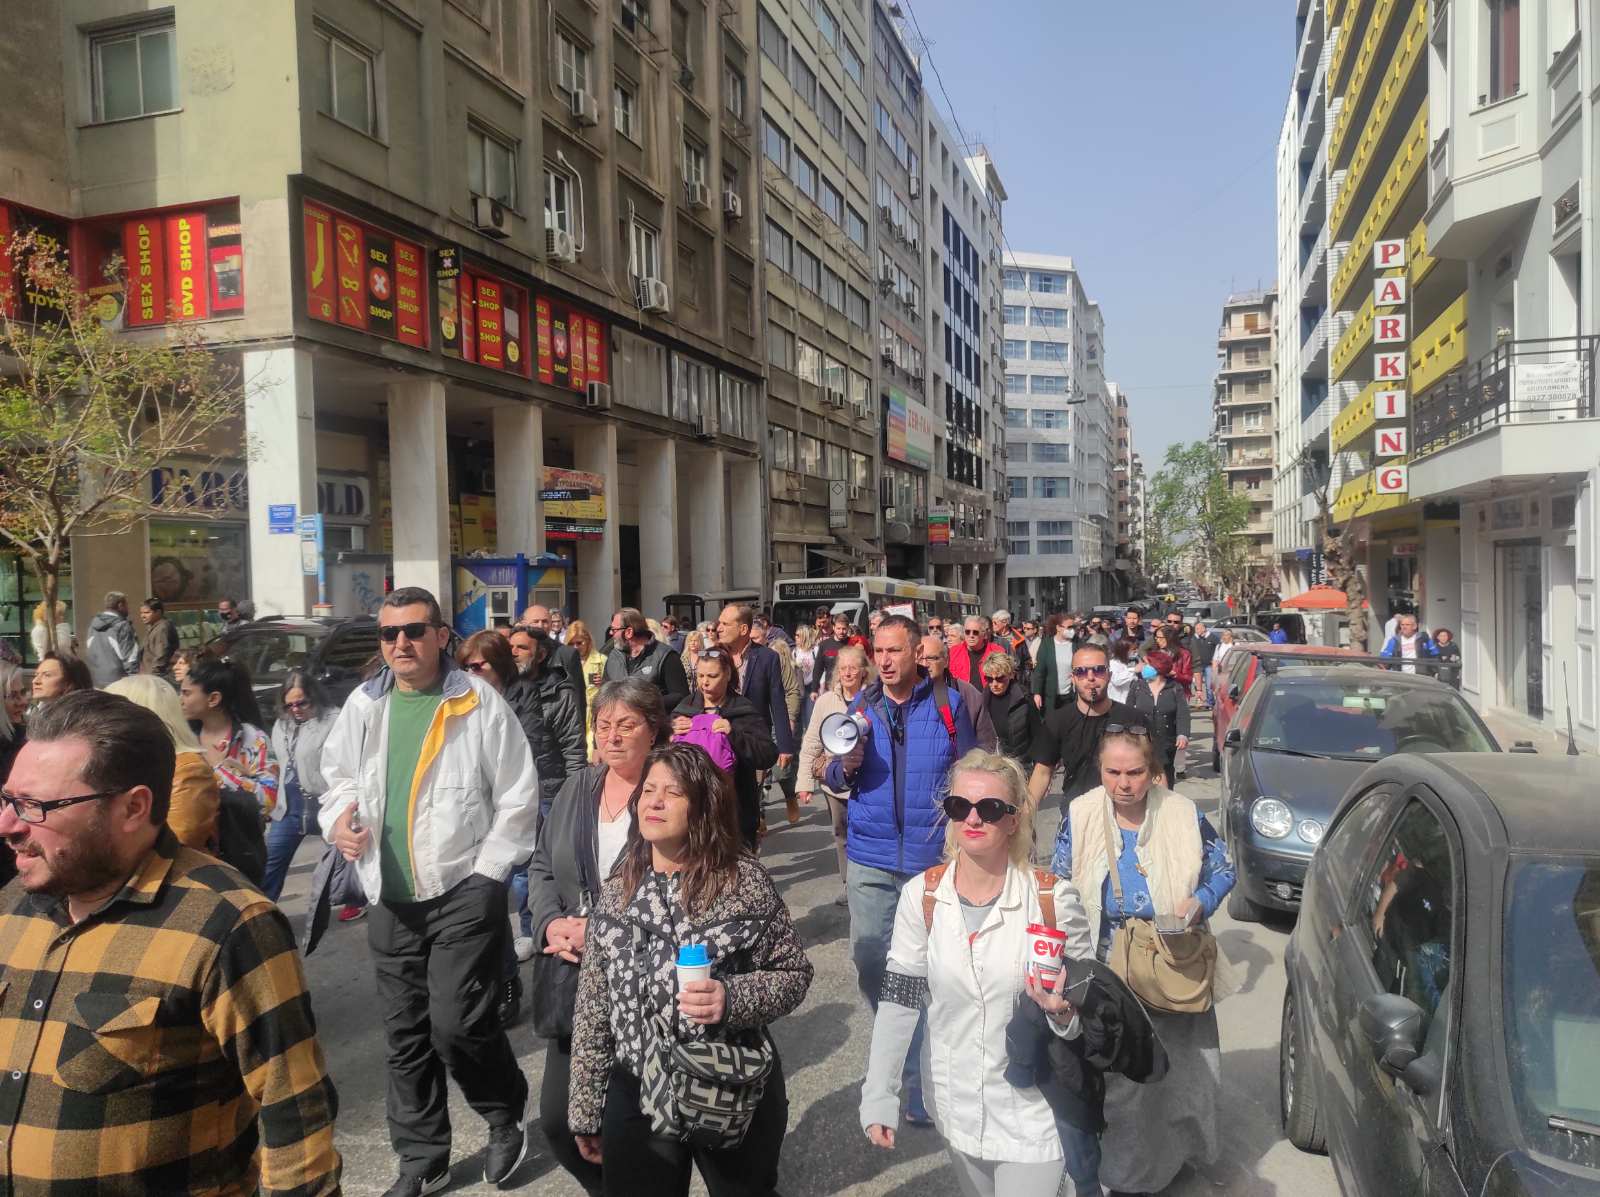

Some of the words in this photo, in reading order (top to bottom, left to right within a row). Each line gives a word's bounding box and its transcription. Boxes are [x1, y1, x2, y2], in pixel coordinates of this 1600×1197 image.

[138, 223, 152, 275] SHOP
[178, 218, 192, 272] SHOP
[370, 249, 388, 264] SEX
[141, 281, 154, 320] SEX
[181, 277, 194, 316] DVD
[479, 300, 500, 311] SHOP
[481, 286, 496, 297] SEX
[369, 305, 393, 320] SHOP
[1379, 243, 1403, 490] PARKING
